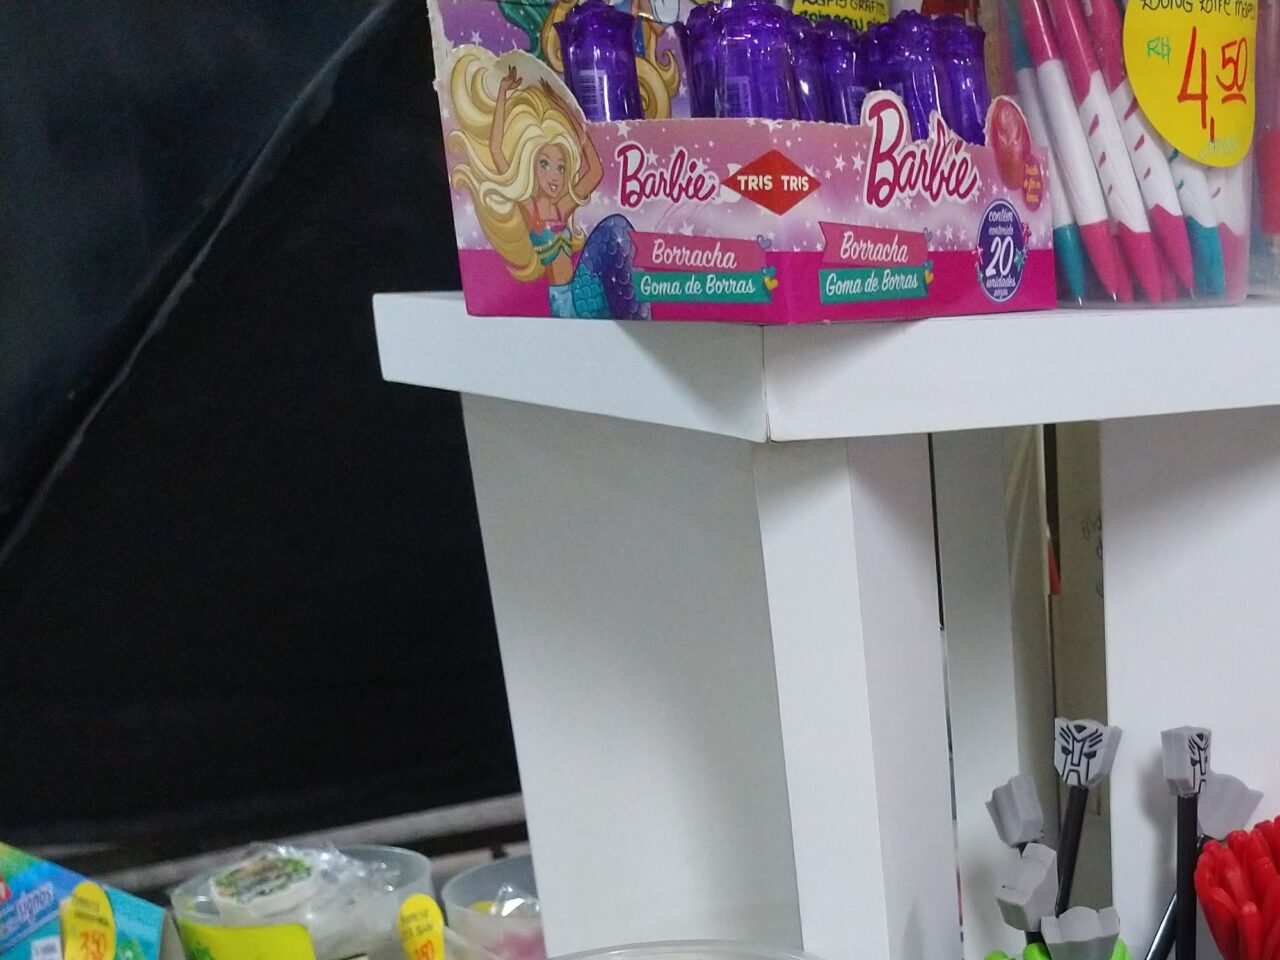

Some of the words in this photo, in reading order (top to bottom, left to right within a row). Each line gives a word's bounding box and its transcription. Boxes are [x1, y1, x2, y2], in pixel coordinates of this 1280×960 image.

[868, 99, 976, 208] Barbie
[617, 143, 717, 208] Barbie
[737, 174, 773, 191] TRIS
[781, 175, 809, 191] TRIS
[651, 238, 738, 270] Borracha
[840, 232, 909, 263] Borracha
[985, 236, 1014, 278] 20
[640, 275, 683, 296] Goma
[685, 276, 702, 294] de
[705, 274, 756, 295] Borras
[825, 271, 863, 296] Goma
[865, 274, 880, 292] de
[881, 268, 920, 291] Borras
